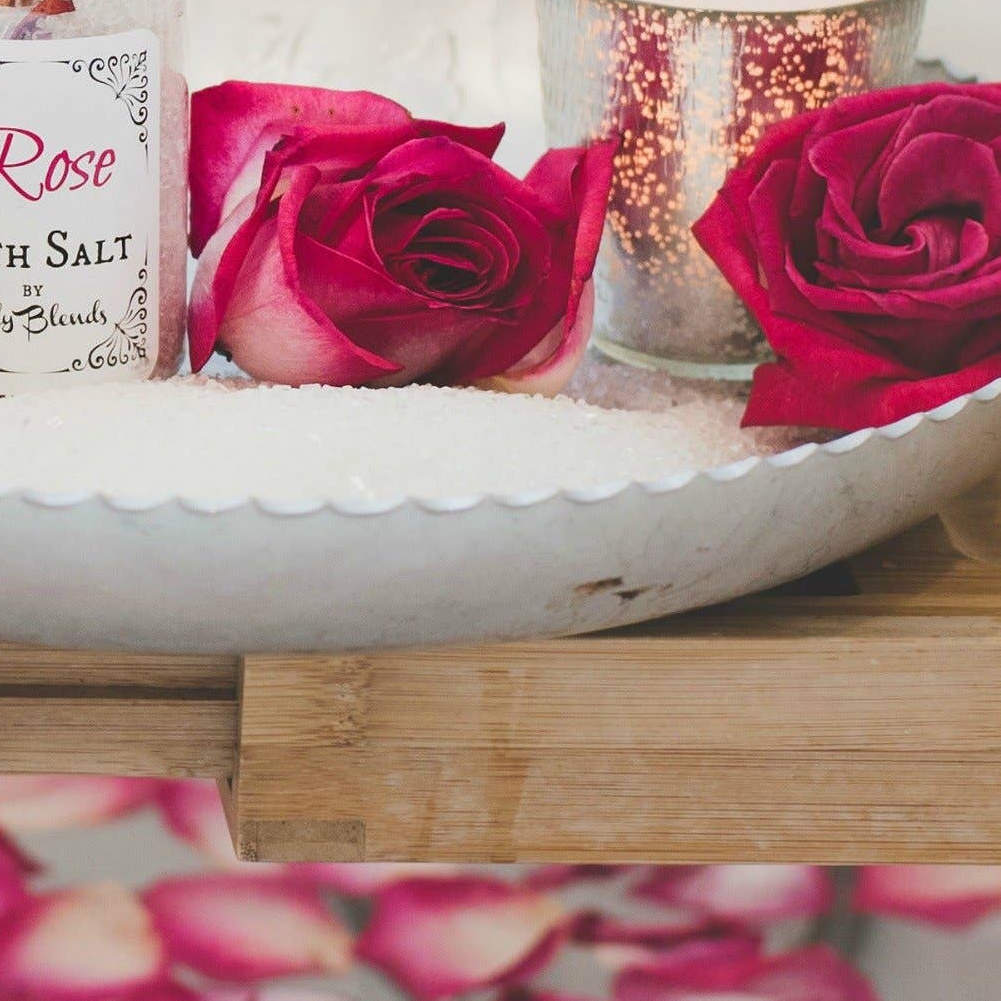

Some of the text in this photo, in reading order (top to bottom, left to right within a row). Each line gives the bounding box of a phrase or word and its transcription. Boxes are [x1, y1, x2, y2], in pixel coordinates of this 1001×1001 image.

[45, 229, 133, 268] SALT
[22, 284, 44, 298] BY
[12, 299, 107, 342] Blends
